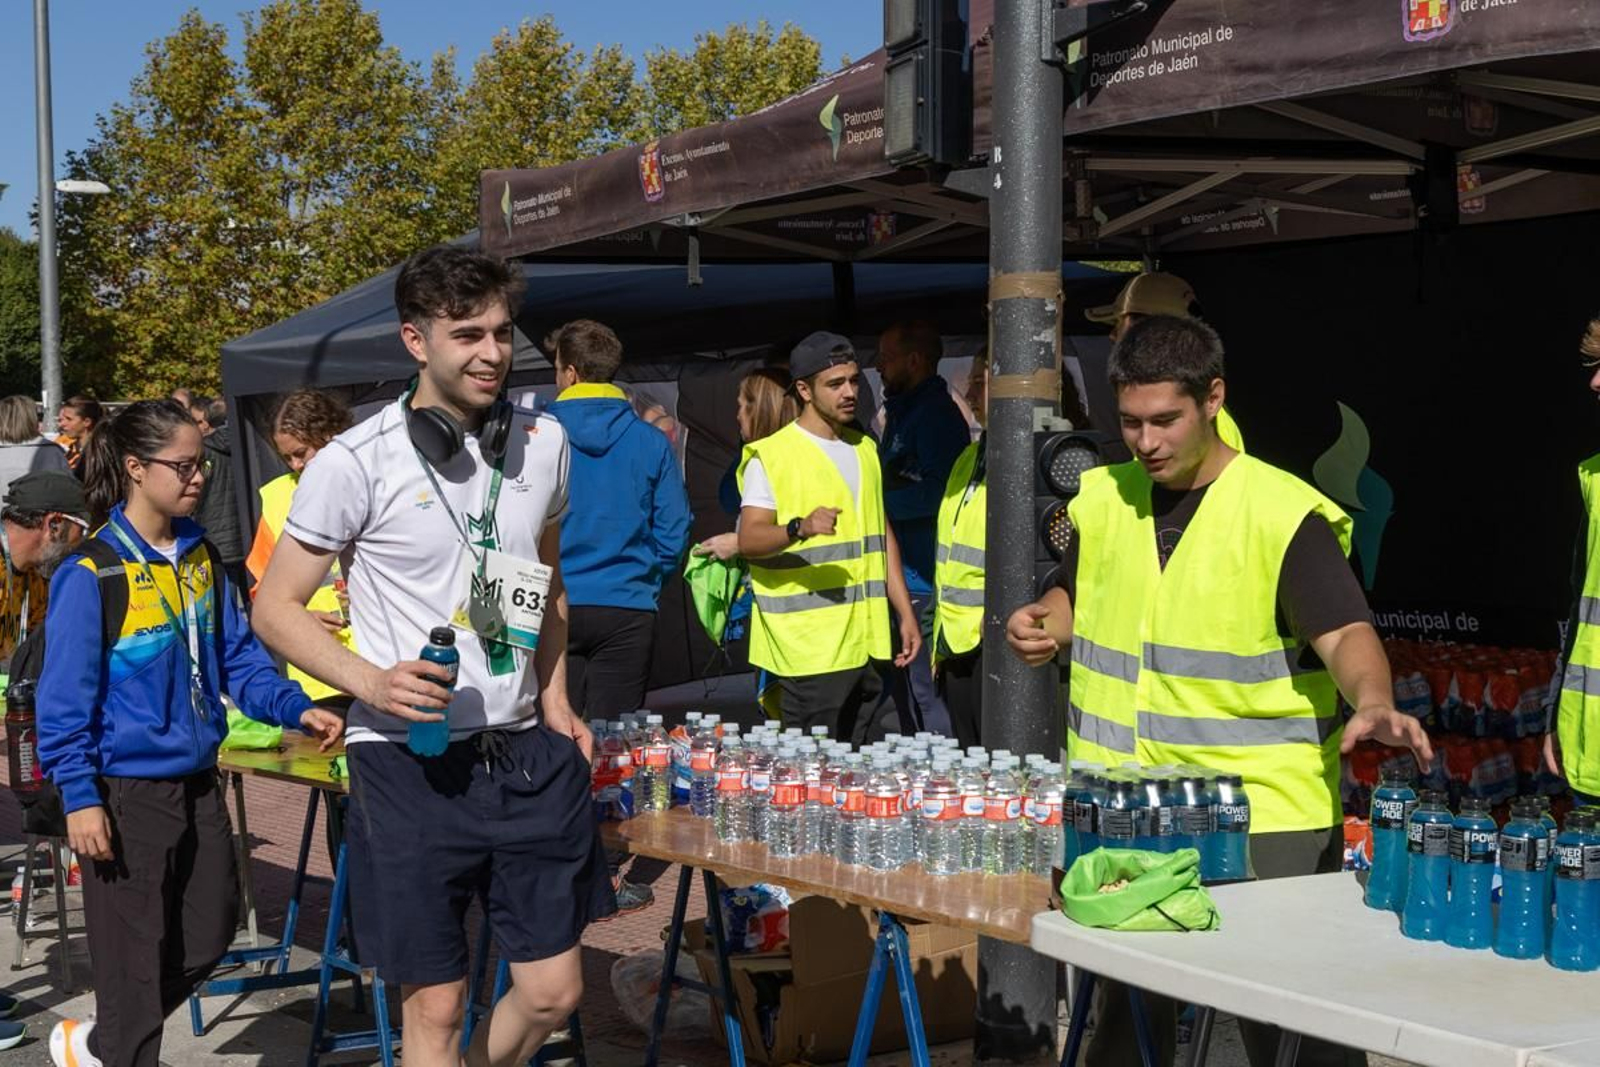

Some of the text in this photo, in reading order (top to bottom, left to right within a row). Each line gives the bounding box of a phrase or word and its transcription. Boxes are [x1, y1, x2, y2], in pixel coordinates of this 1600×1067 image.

[1092, 25, 1233, 67] Patronato Municipal de
[1090, 53, 1198, 88] Deportes de Jaén
[846, 125, 885, 145] Deporte
[664, 170, 673, 182] de
[1455, 611, 1479, 632] de
[1375, 799, 1403, 811] OWER
